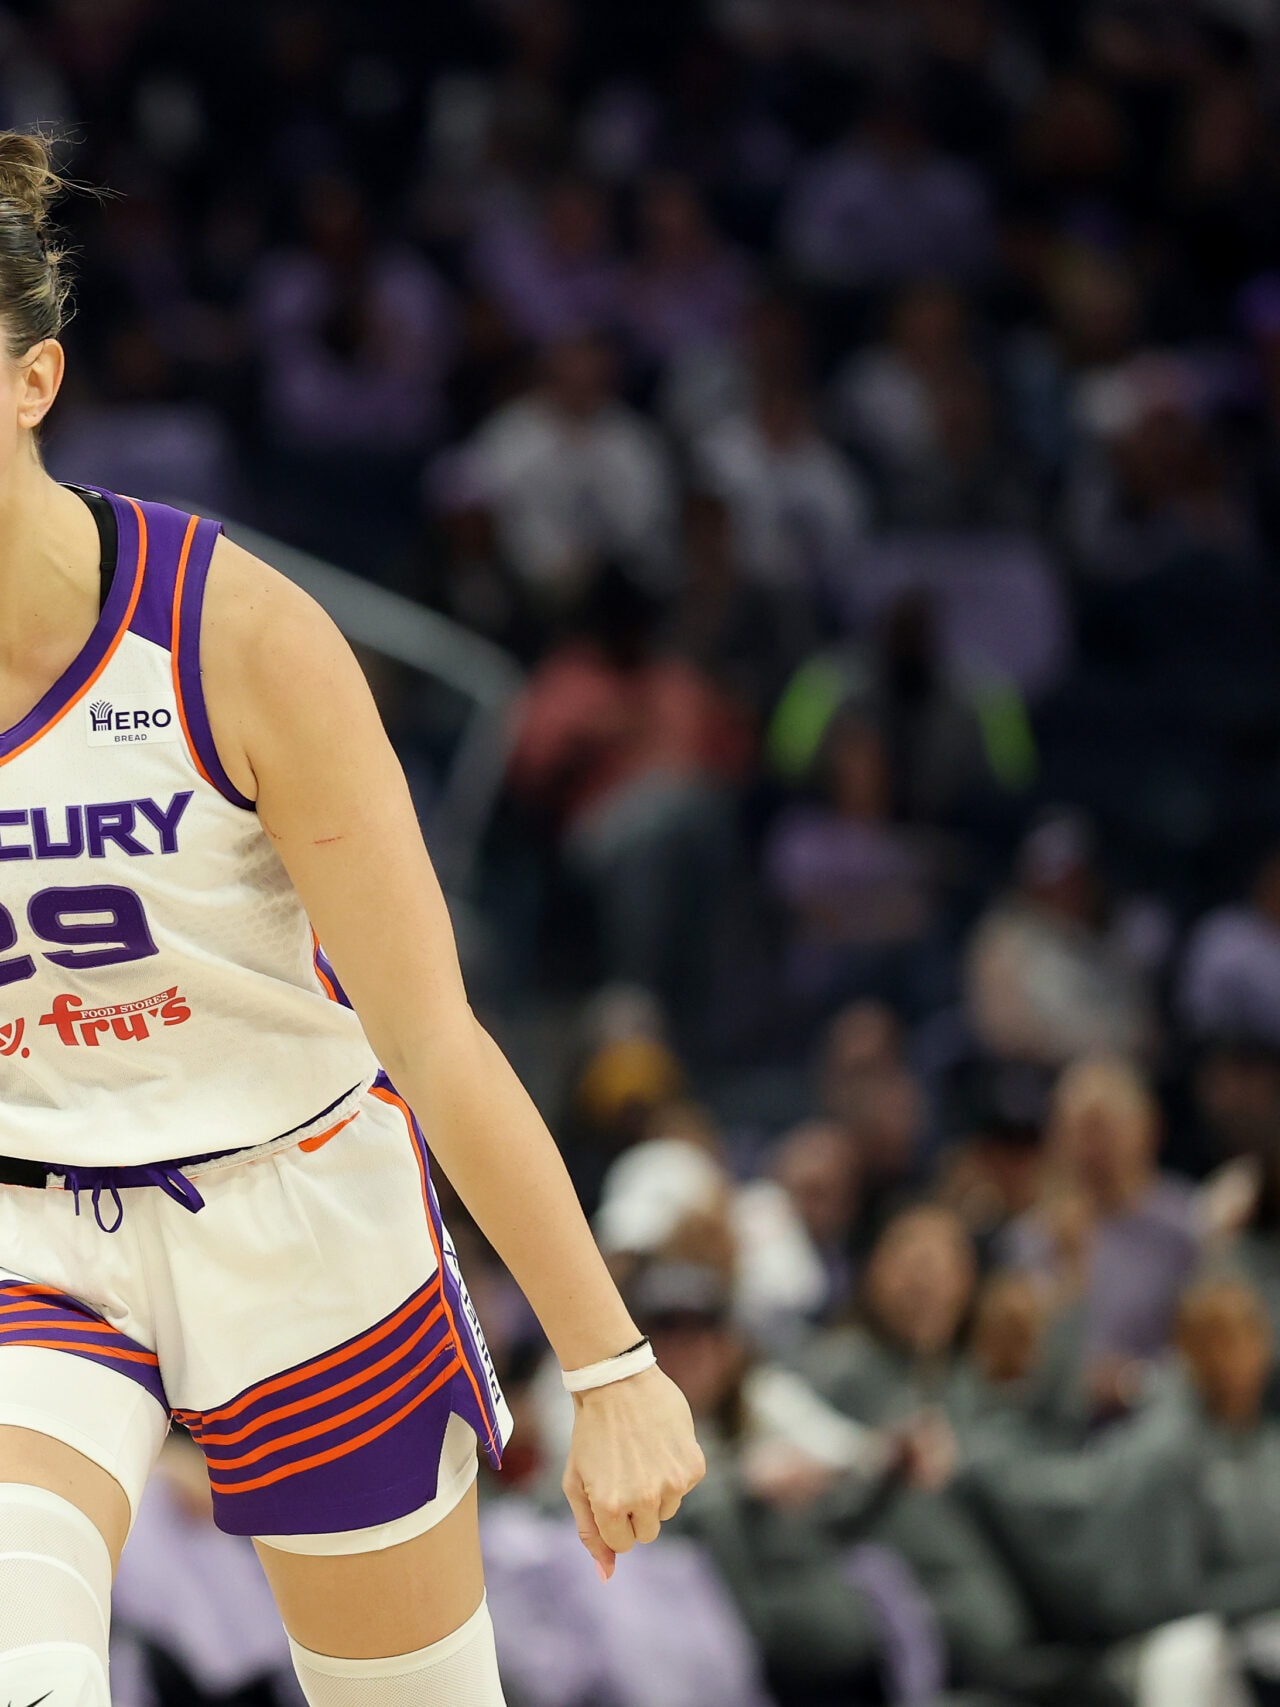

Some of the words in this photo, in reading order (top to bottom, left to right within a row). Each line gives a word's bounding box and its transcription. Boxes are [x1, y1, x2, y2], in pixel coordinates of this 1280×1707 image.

[89, 700, 172, 732] HERO
[114, 733, 148, 743] BREAD
[80, 1007, 116, 1019] FOOD
[120, 992, 169, 1013] STORES
